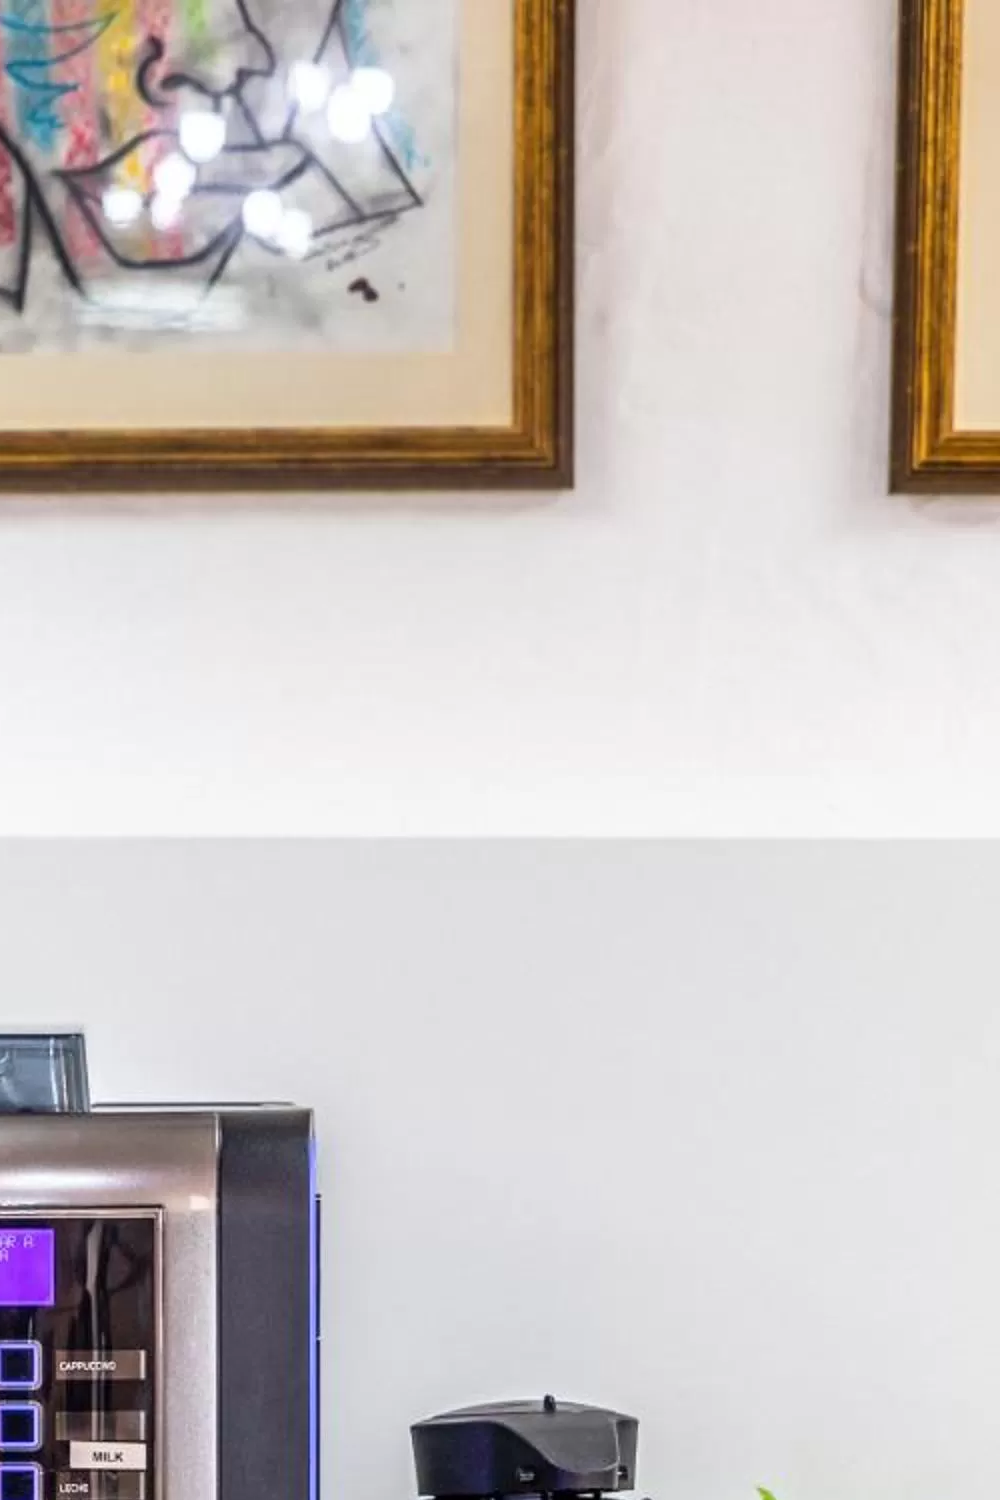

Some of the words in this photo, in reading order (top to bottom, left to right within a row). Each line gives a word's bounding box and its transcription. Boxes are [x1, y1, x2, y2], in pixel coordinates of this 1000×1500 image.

[23, 1235, 33, 1249] A
[59, 1361, 117, 1371] CAPPUCCINO
[91, 1451, 124, 1462] MILK
[59, 1483, 89, 1493] LECHE
